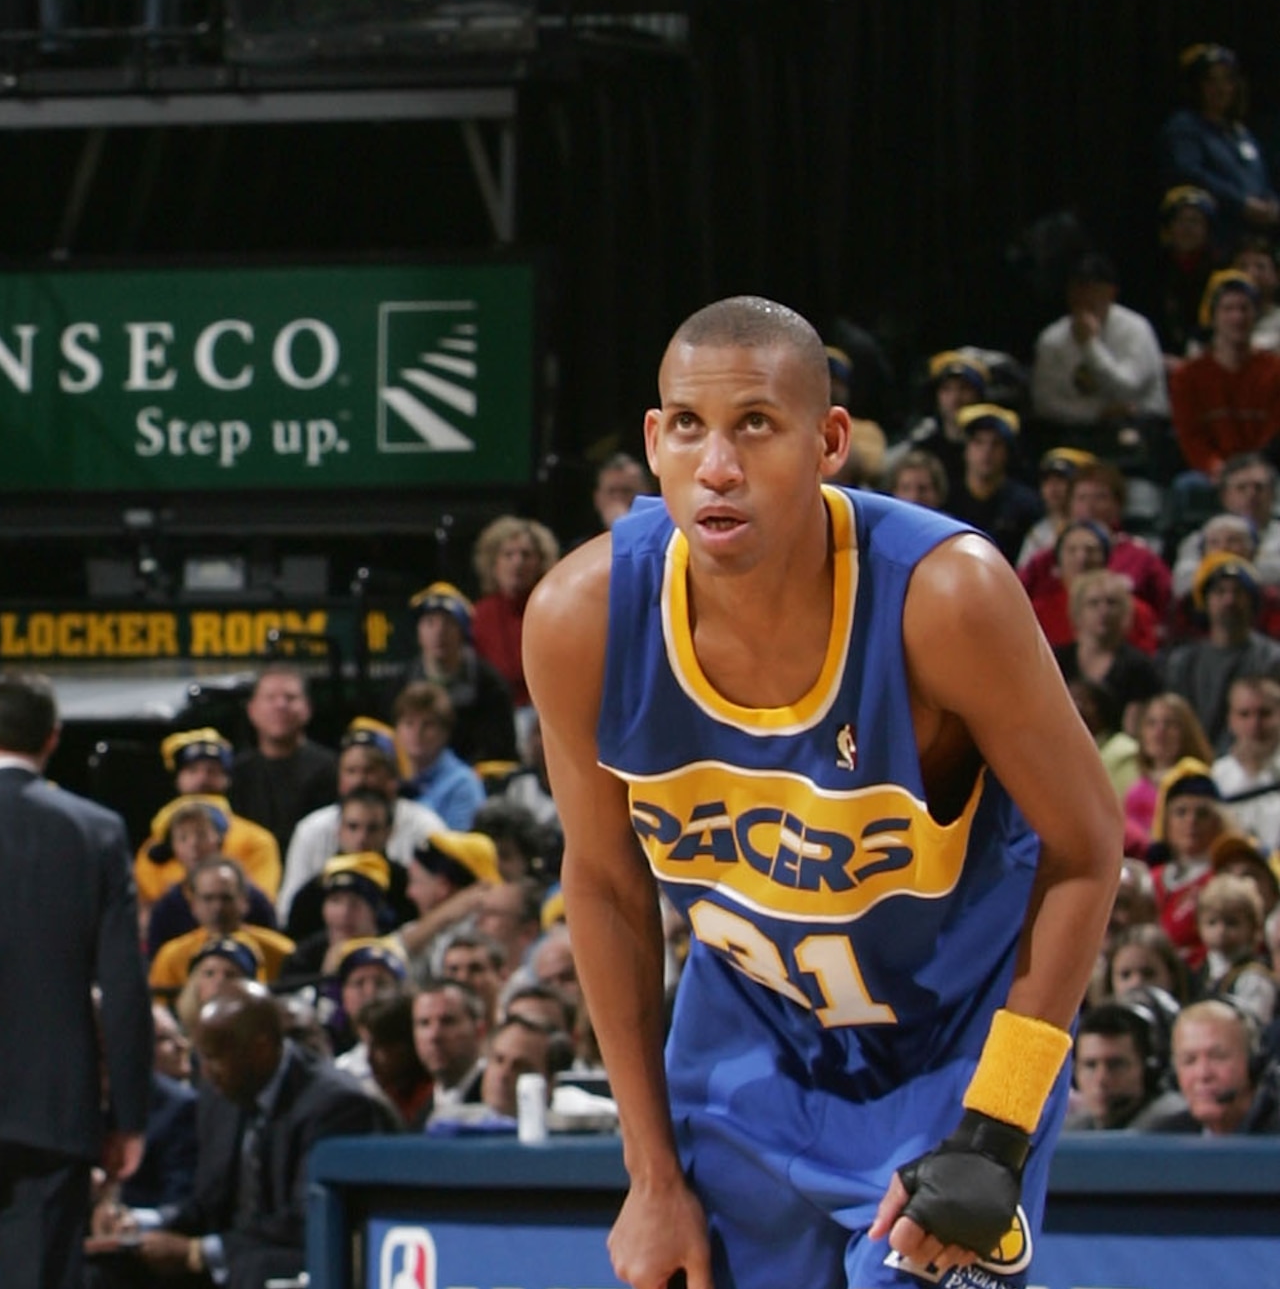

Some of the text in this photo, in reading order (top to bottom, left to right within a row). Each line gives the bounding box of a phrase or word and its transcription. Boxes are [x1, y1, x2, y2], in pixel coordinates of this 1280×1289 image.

[134, 406, 351, 467] Step up.
[0, 612, 177, 657] LOCKER
[631, 799, 914, 893] PACERS
